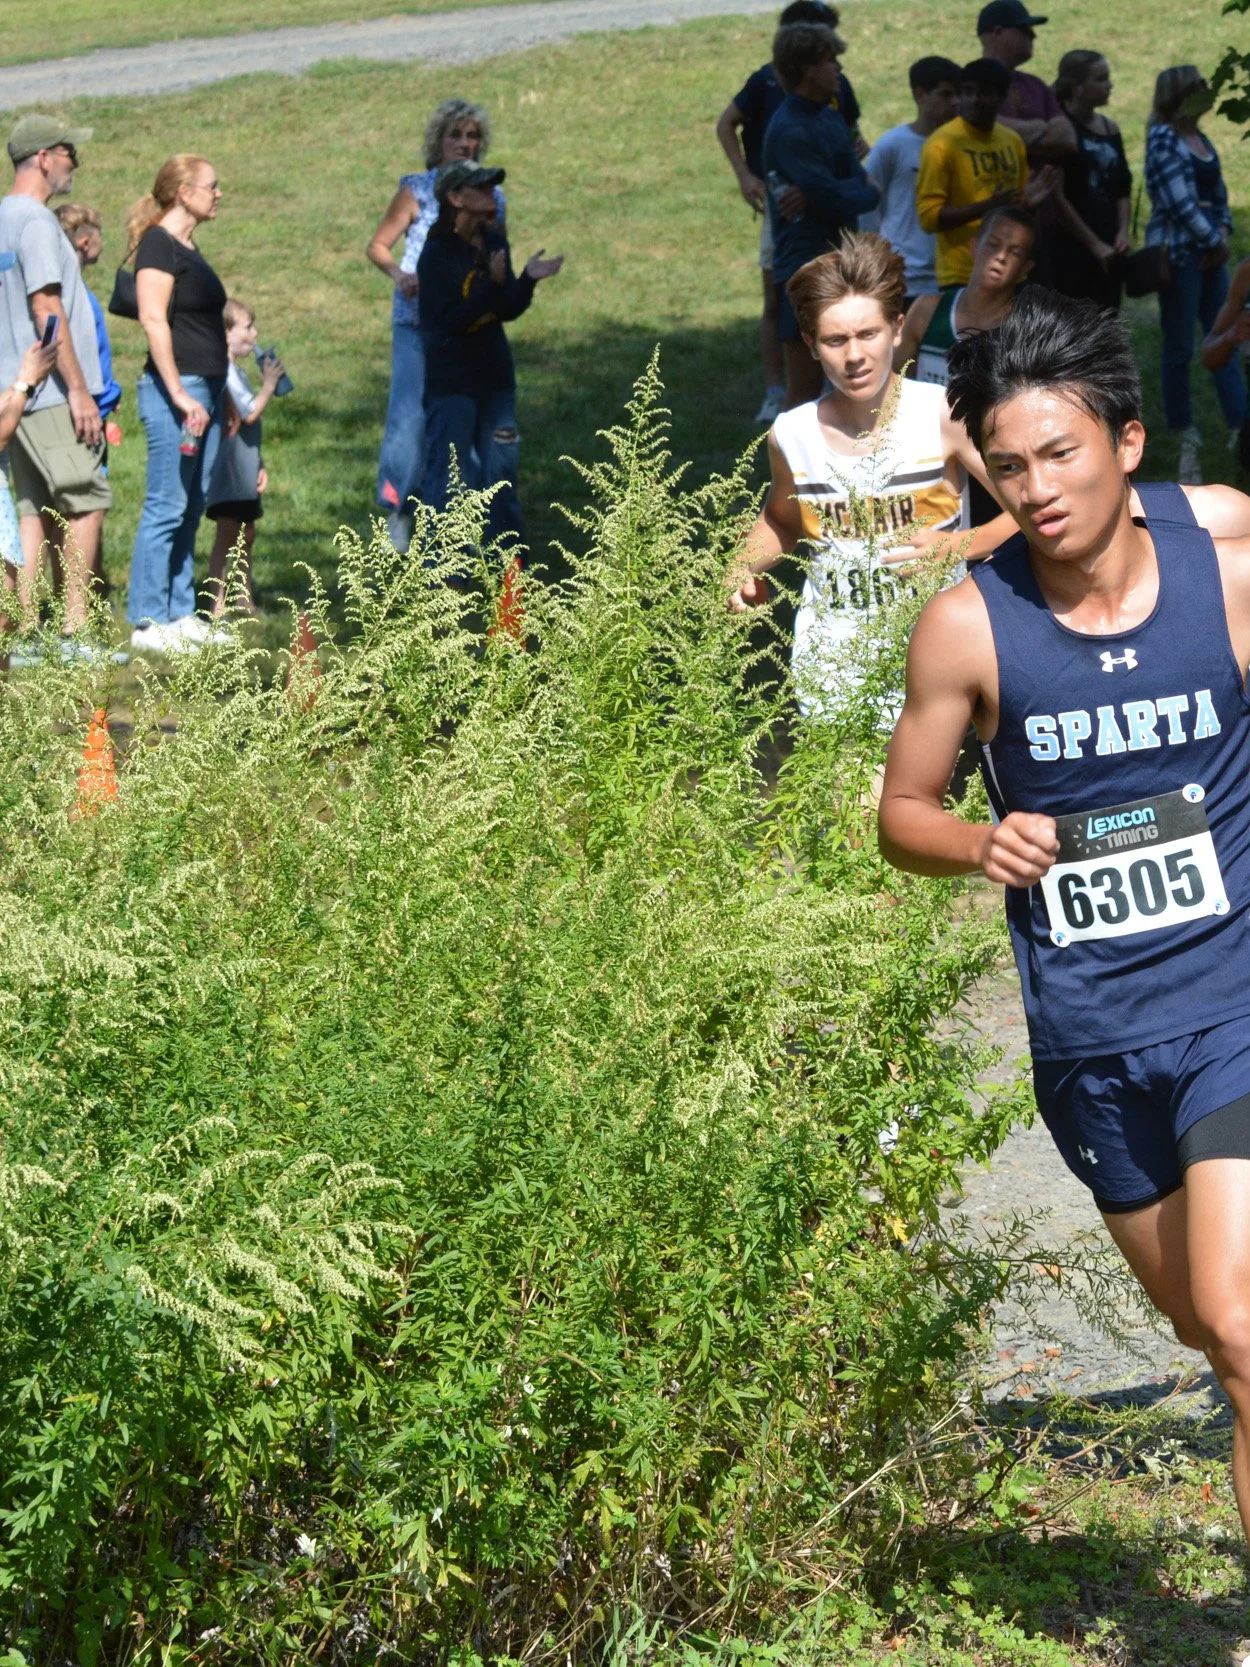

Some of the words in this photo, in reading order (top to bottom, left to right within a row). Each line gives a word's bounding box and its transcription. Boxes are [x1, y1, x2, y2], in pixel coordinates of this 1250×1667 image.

[963, 144, 1017, 177] TCNJ
[826, 566, 918, 610] 186
[1025, 689, 1221, 761] SPARTA
[1087, 807, 1155, 840] LEXICON
[1100, 824, 1158, 848] TIMING
[1058, 848, 1205, 929] 6305
